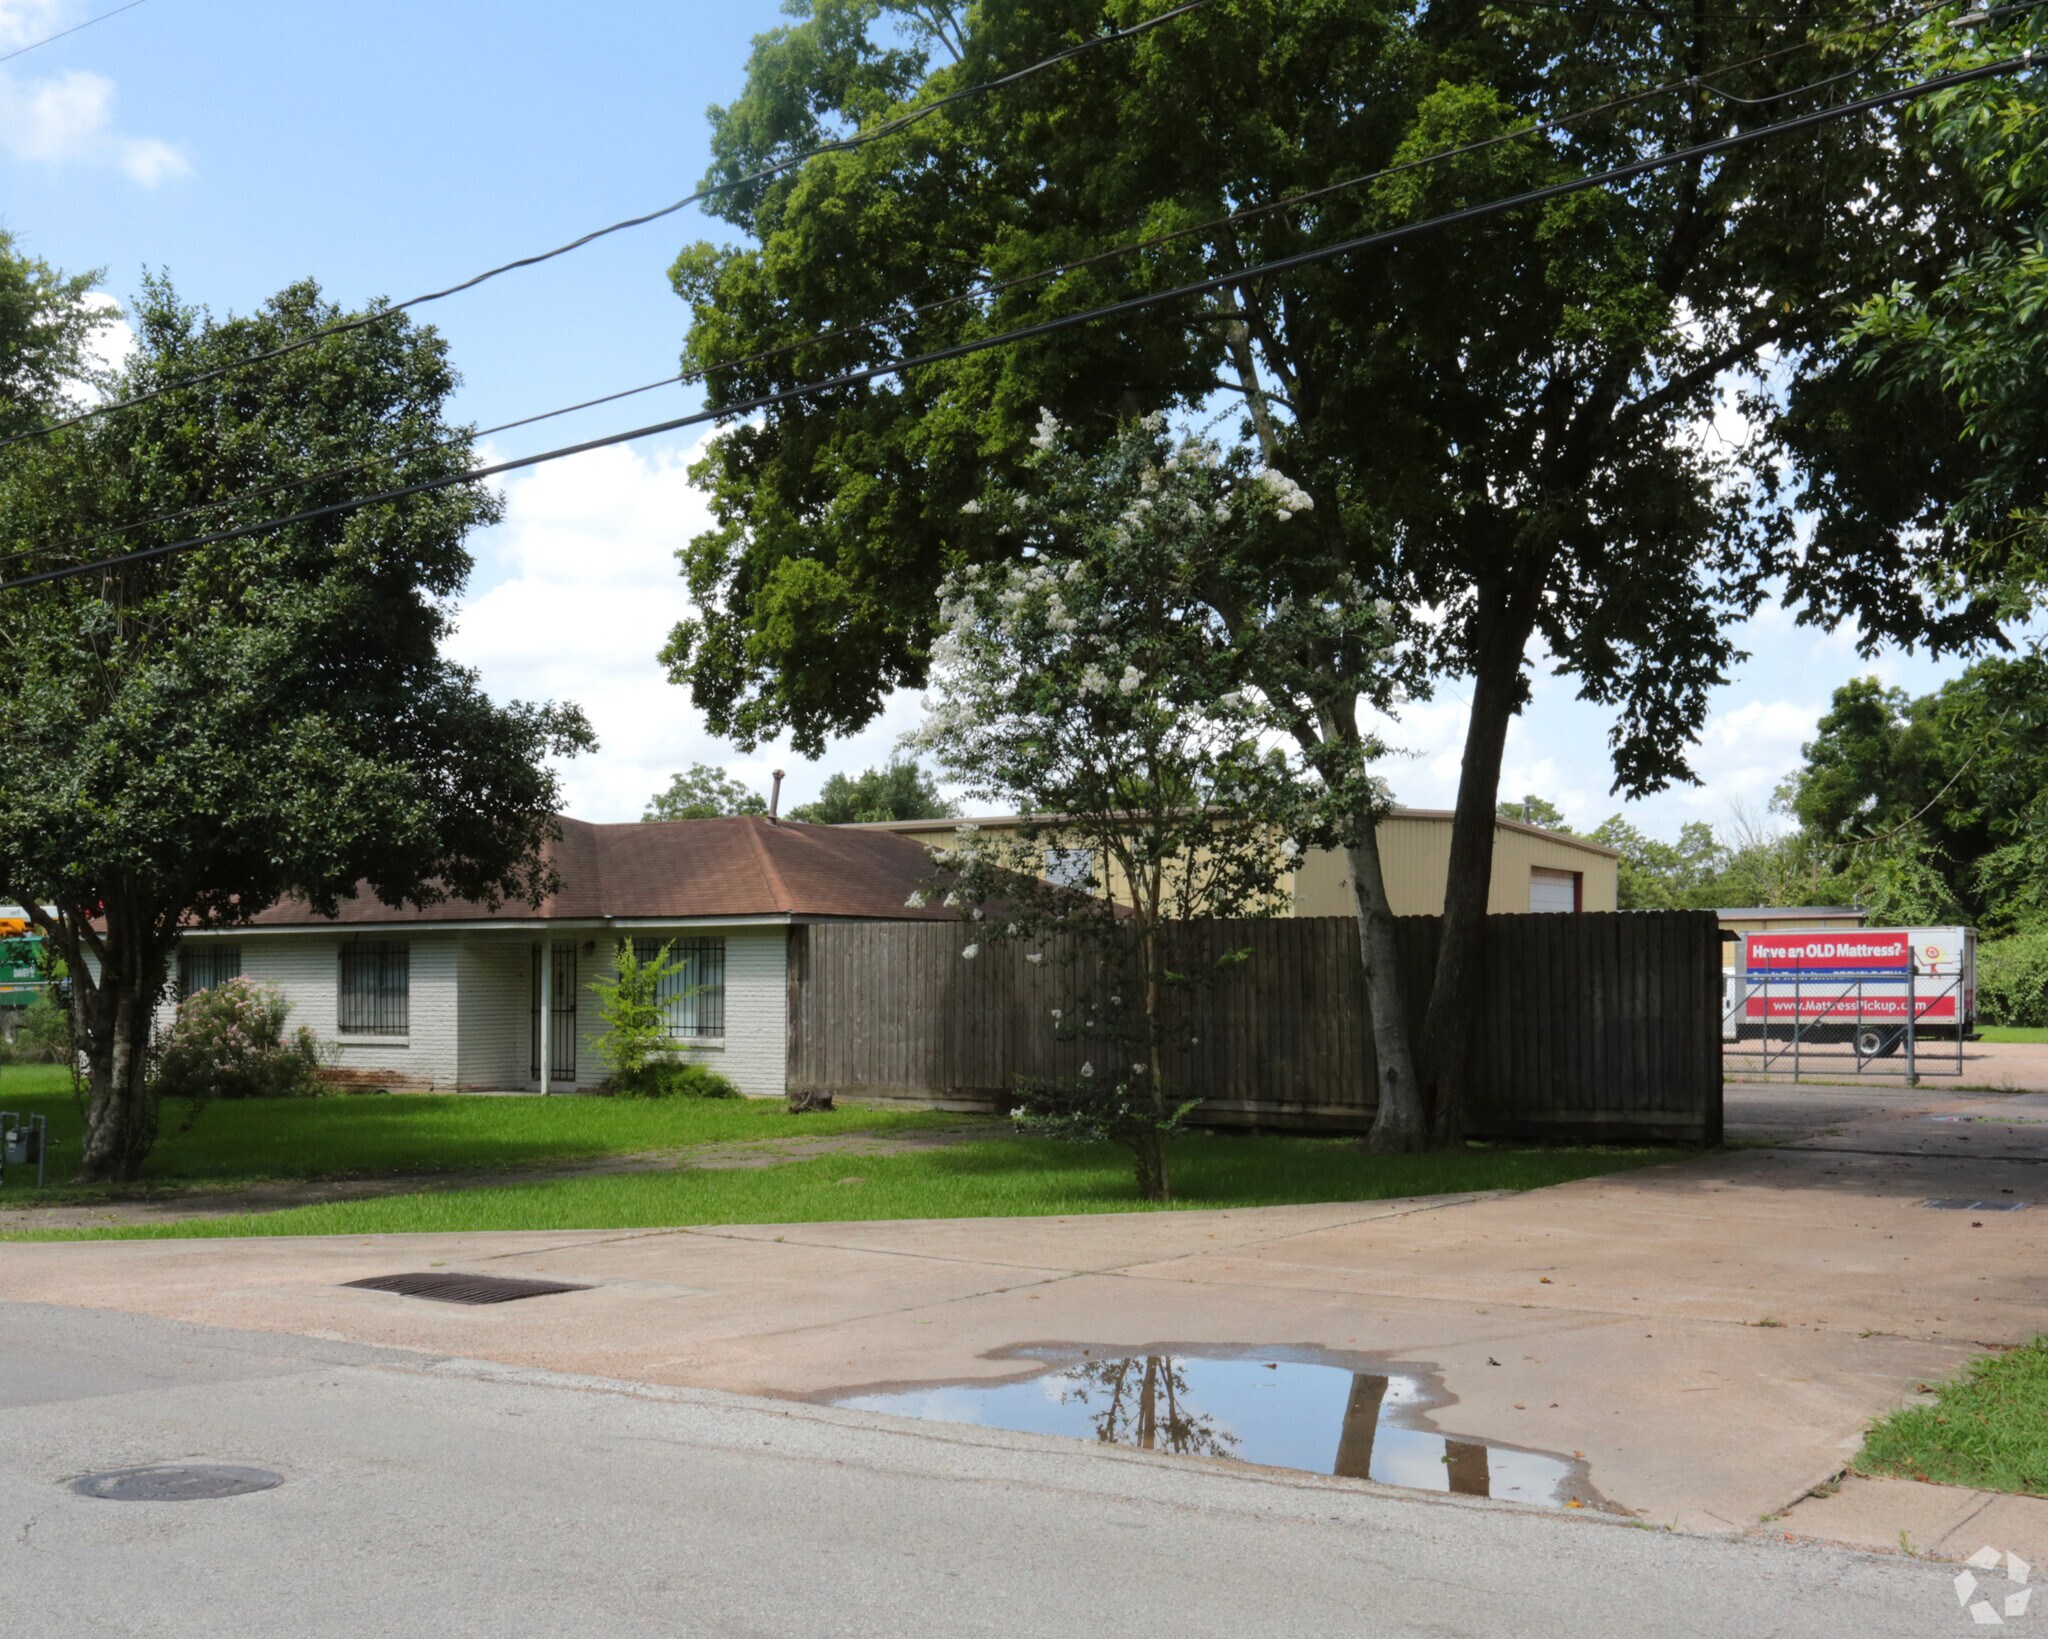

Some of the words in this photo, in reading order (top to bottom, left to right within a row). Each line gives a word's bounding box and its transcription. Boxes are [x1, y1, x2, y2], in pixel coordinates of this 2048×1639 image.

[1752, 944, 1786, 958] Have
[1787, 947, 1805, 958] an
[1806, 943, 1835, 957] OLD
[1836, 942, 1902, 957] Mattress?
[1773, 999, 1927, 1013] www.MattressPickup.cm
